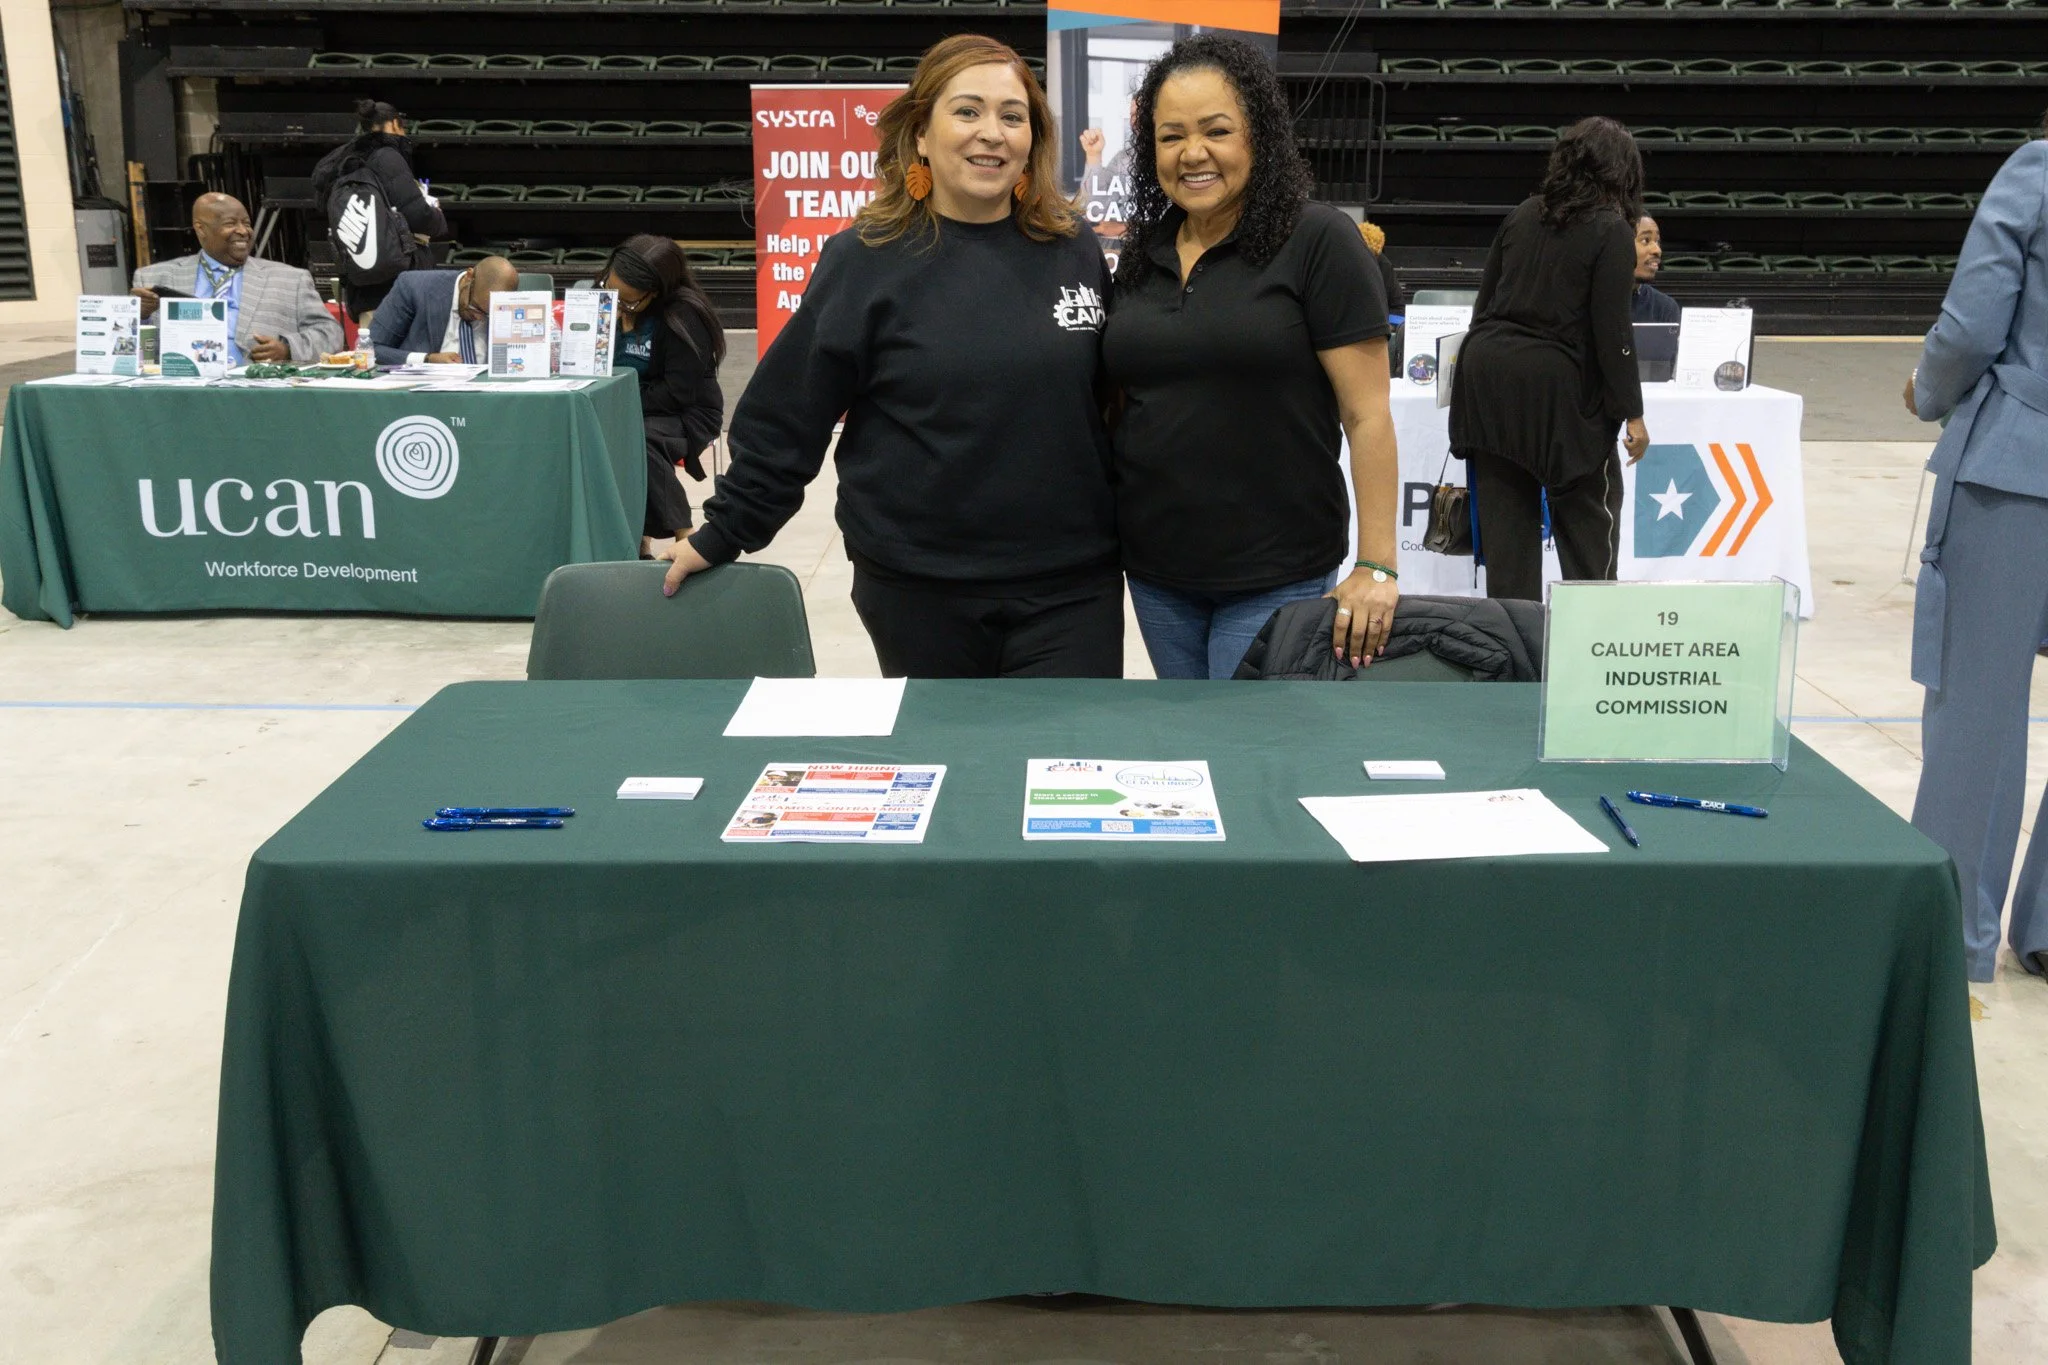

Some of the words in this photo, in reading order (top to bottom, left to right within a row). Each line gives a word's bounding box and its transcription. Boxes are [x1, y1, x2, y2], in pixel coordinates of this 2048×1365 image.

[762, 150, 830, 179] JOIN
[840, 150, 880, 179] OU
[336, 193, 371, 253] NIKE
[766, 234, 811, 257] Help
[772, 262, 805, 281] the
[450, 416, 466, 428] TM
[138, 478, 376, 539] ucan
[205, 561, 298, 578] Workforce
[303, 562, 418, 583] Development
[1657, 611, 1679, 626] 19
[1590, 642, 1685, 658] CALUMET
[1687, 642, 1741, 657] AREA
[1605, 671, 1723, 686] INDUSTRIAL
[1595, 700, 1728, 715] COMMISSION
[751, 804, 814, 812] ESTAMOS
[816, 805, 916, 813] CONTRATANDO
